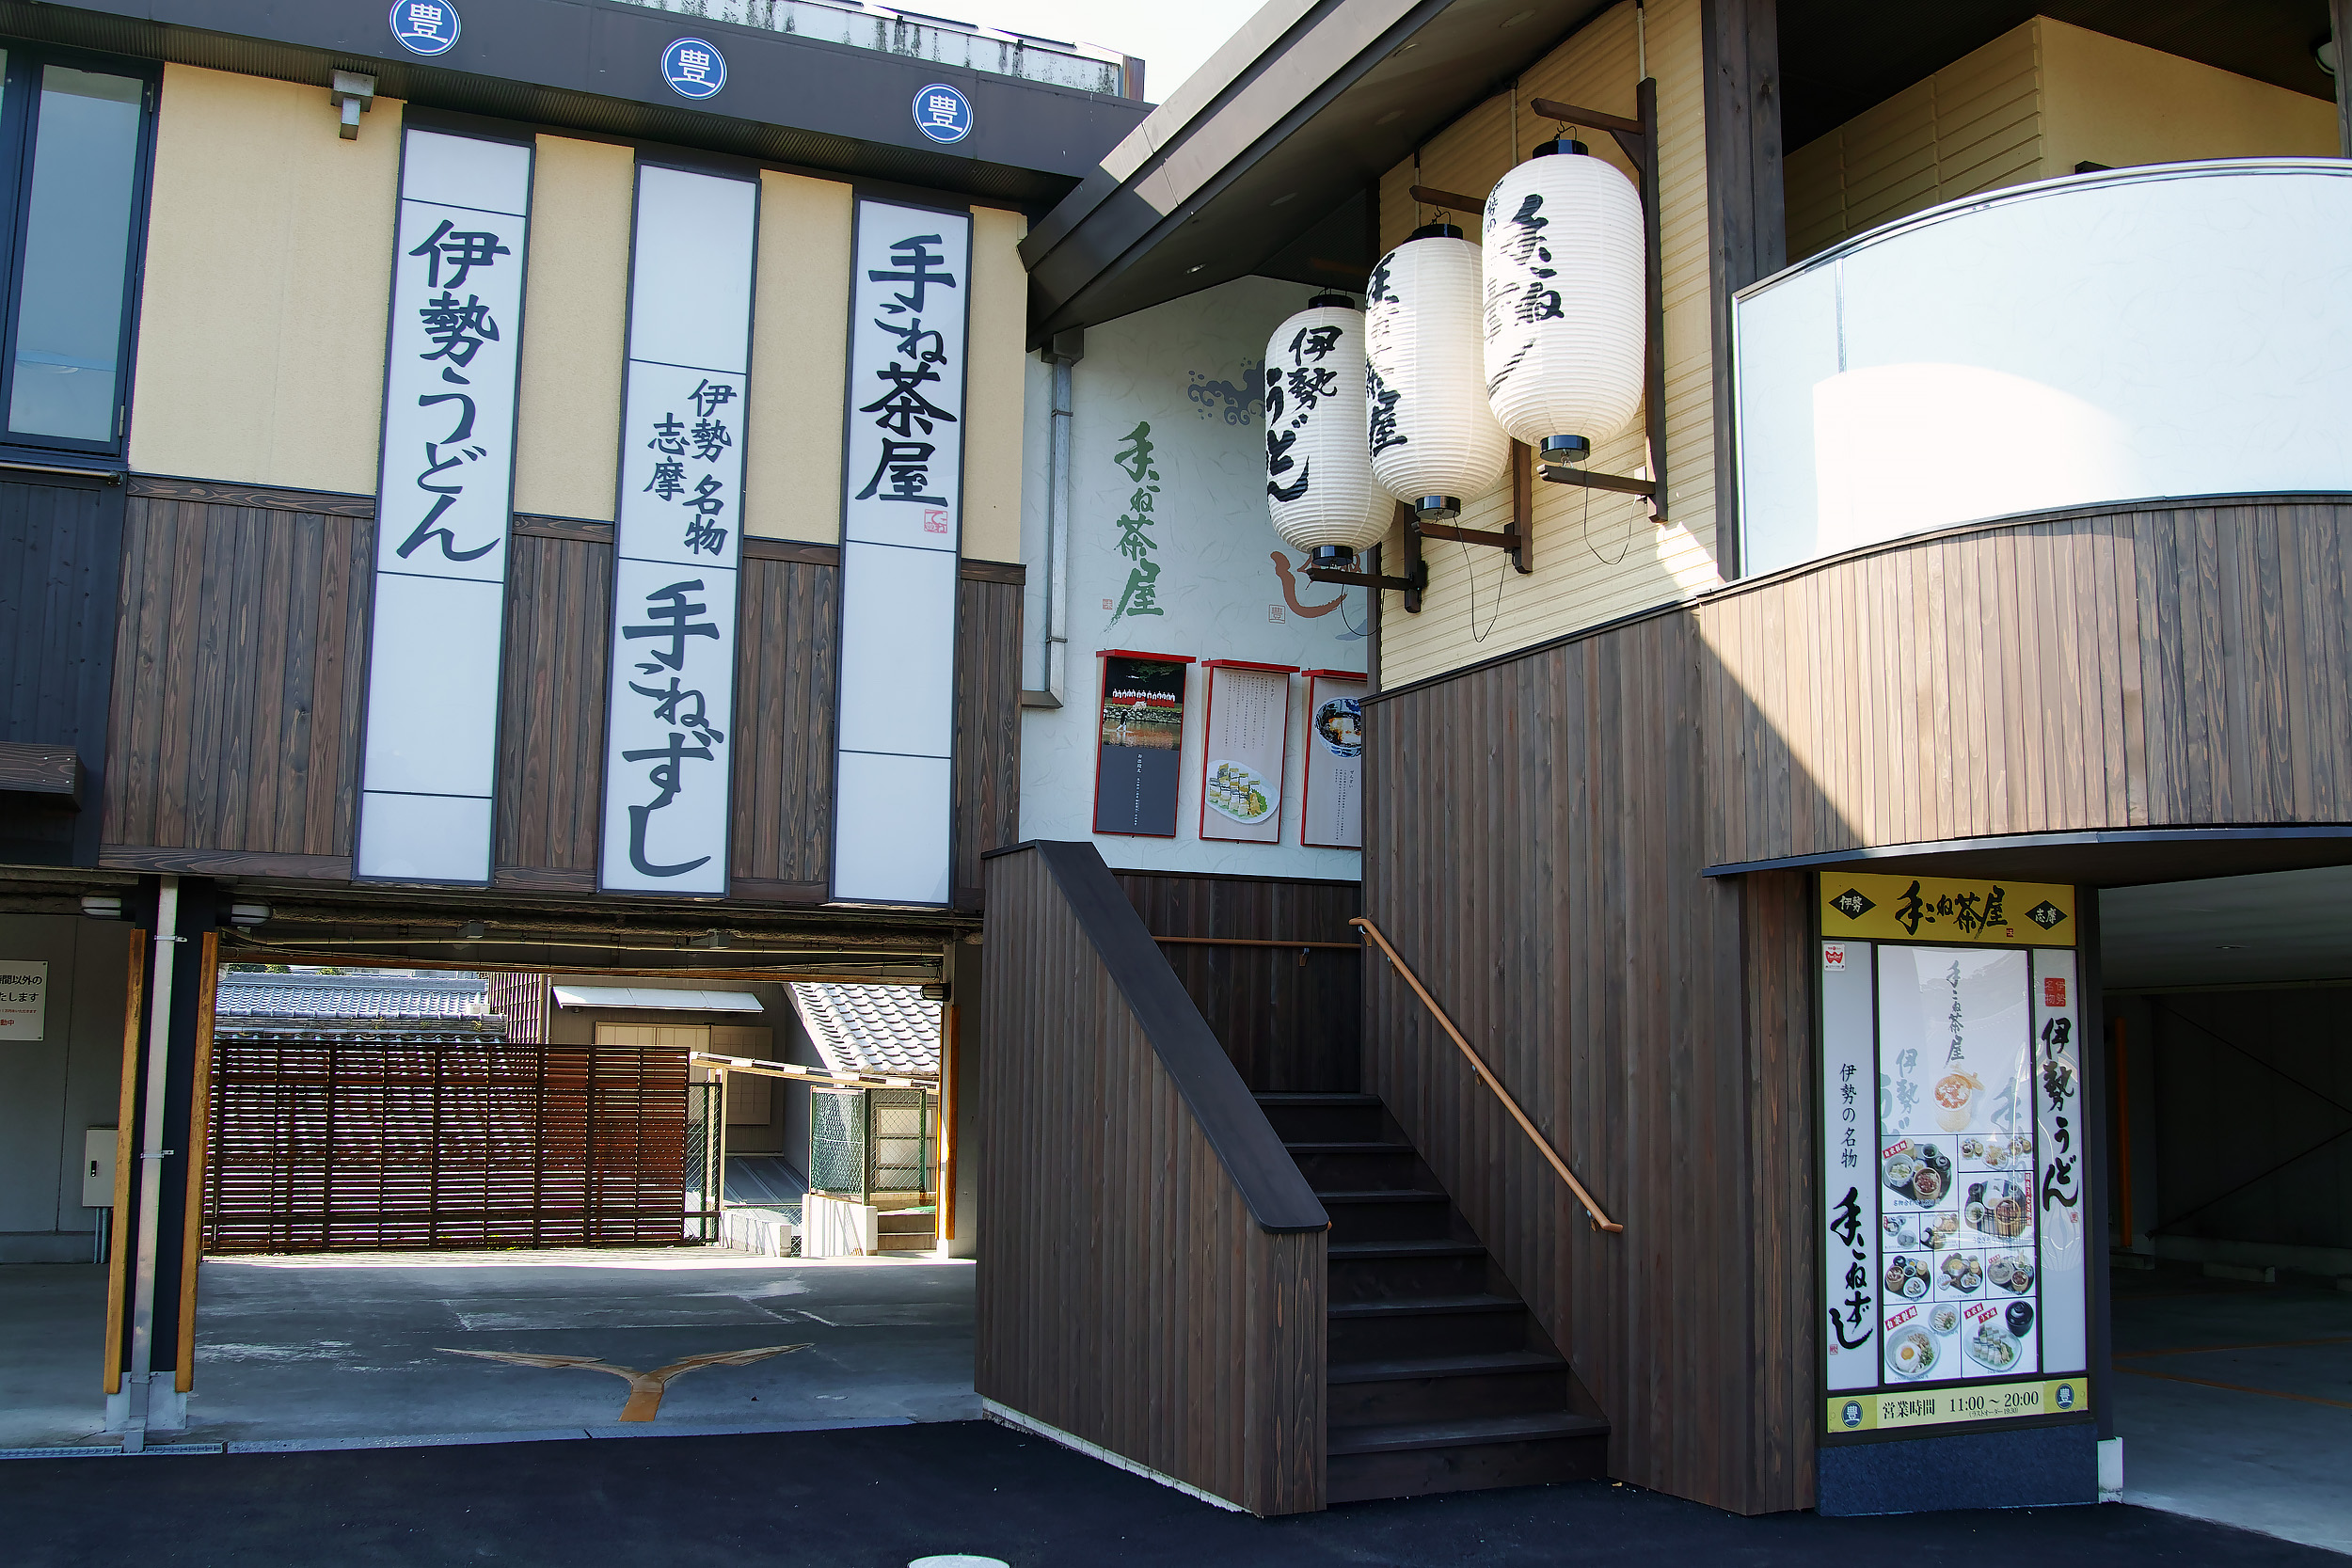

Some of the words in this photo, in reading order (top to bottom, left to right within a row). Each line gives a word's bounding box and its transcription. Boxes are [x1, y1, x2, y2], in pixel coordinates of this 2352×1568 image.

[401, 3, 449, 43] 豊
[671, 49, 716, 88] 豊
[920, 93, 963, 133] 豊
[396, 219, 511, 562] 伊勢うどん
[854, 232, 958, 508] 手こね茶屋
[682, 473, 728, 556] 名物
[622, 578, 724, 878] 手こねずし
[1839, 895, 1863, 913] 伊勢
[1895, 879, 2008, 940] 手こね茶屋
[1944, 959, 1964, 1069] 手こね茶屋
[1839, 1063, 1858, 1167] 伊勢の名物
[2041, 1017, 2079, 1212] 伊勢うどん
[1829, 1187, 1874, 1350] 手こねずし
[1883, 1399, 1935, 1419] 営業時間
[1949, 1395, 1985, 1413] 11:00
[2004, 1390, 2039, 1408] 20:00
